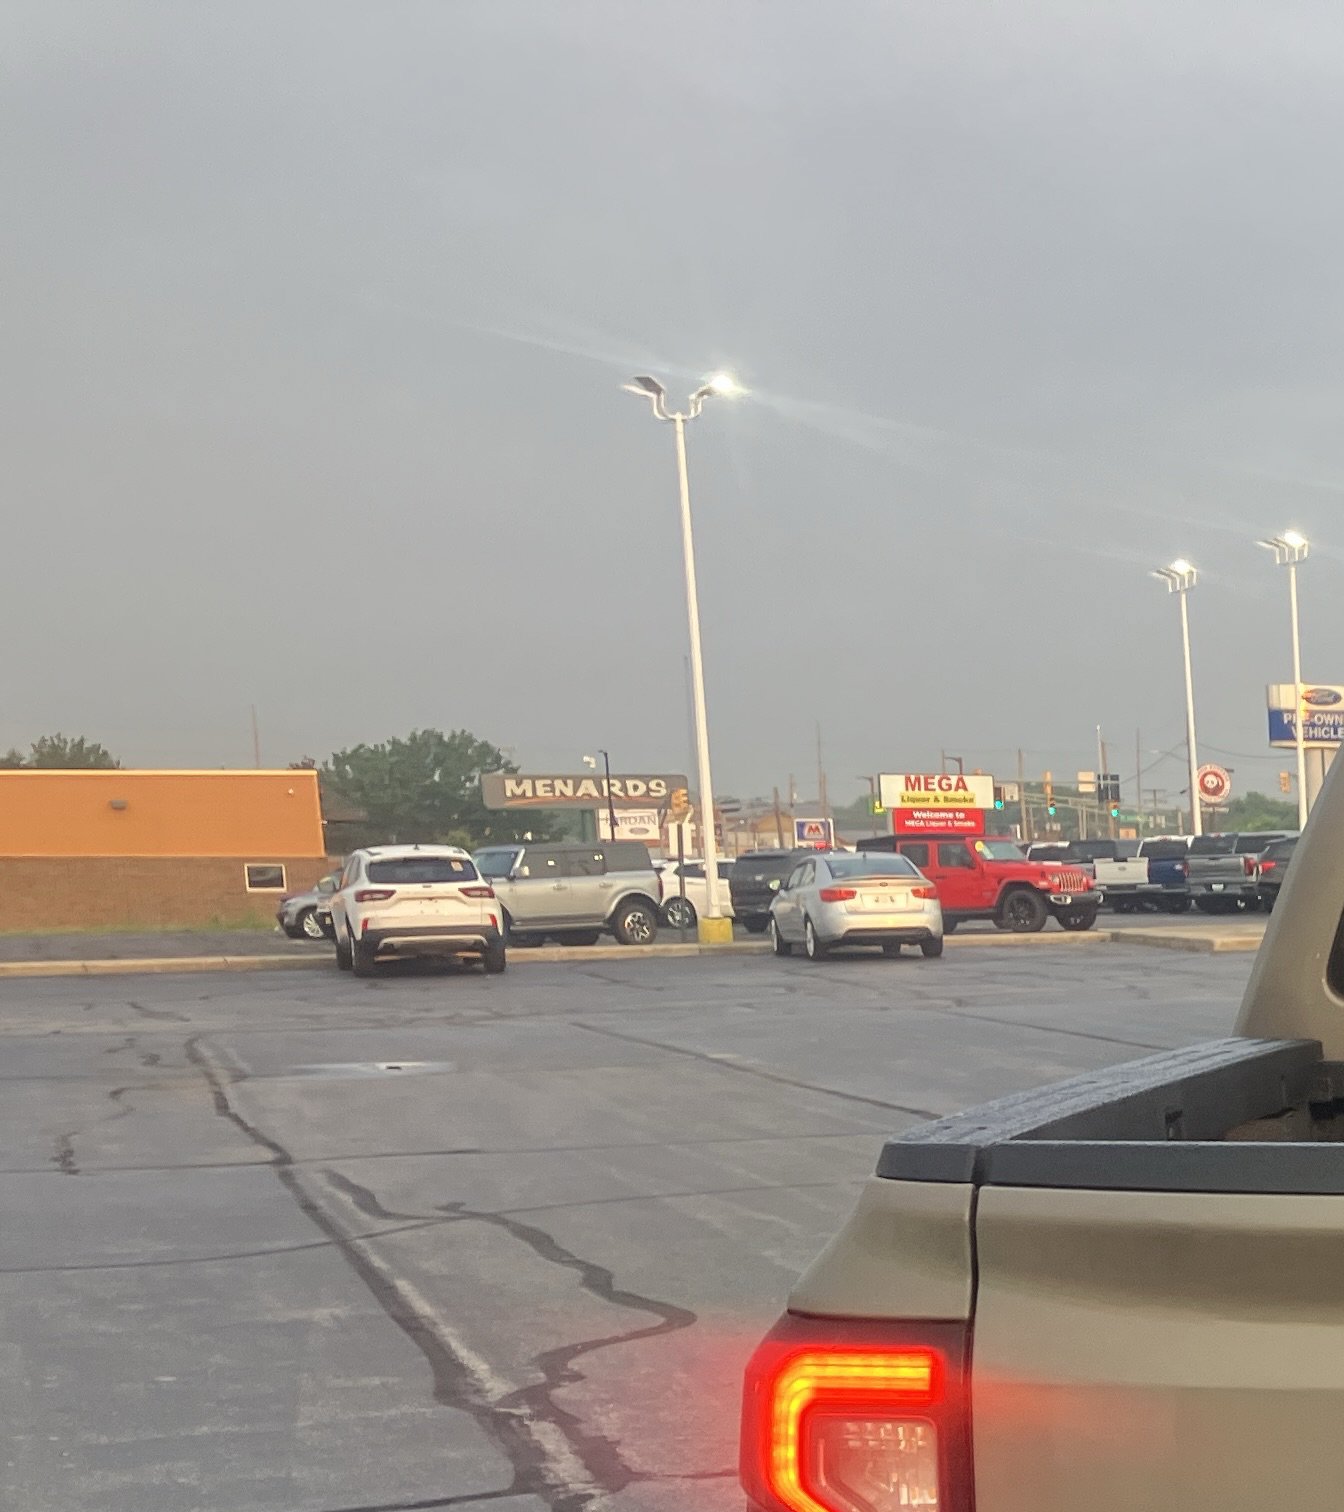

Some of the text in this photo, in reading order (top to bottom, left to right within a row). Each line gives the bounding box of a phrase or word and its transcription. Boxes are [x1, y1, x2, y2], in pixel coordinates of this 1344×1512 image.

[504, 778, 667, 798] MENARDS
[904, 774, 968, 792] MEGA
[912, 810, 965, 819] Welcome to
[904, 819, 925, 827] MEGA
